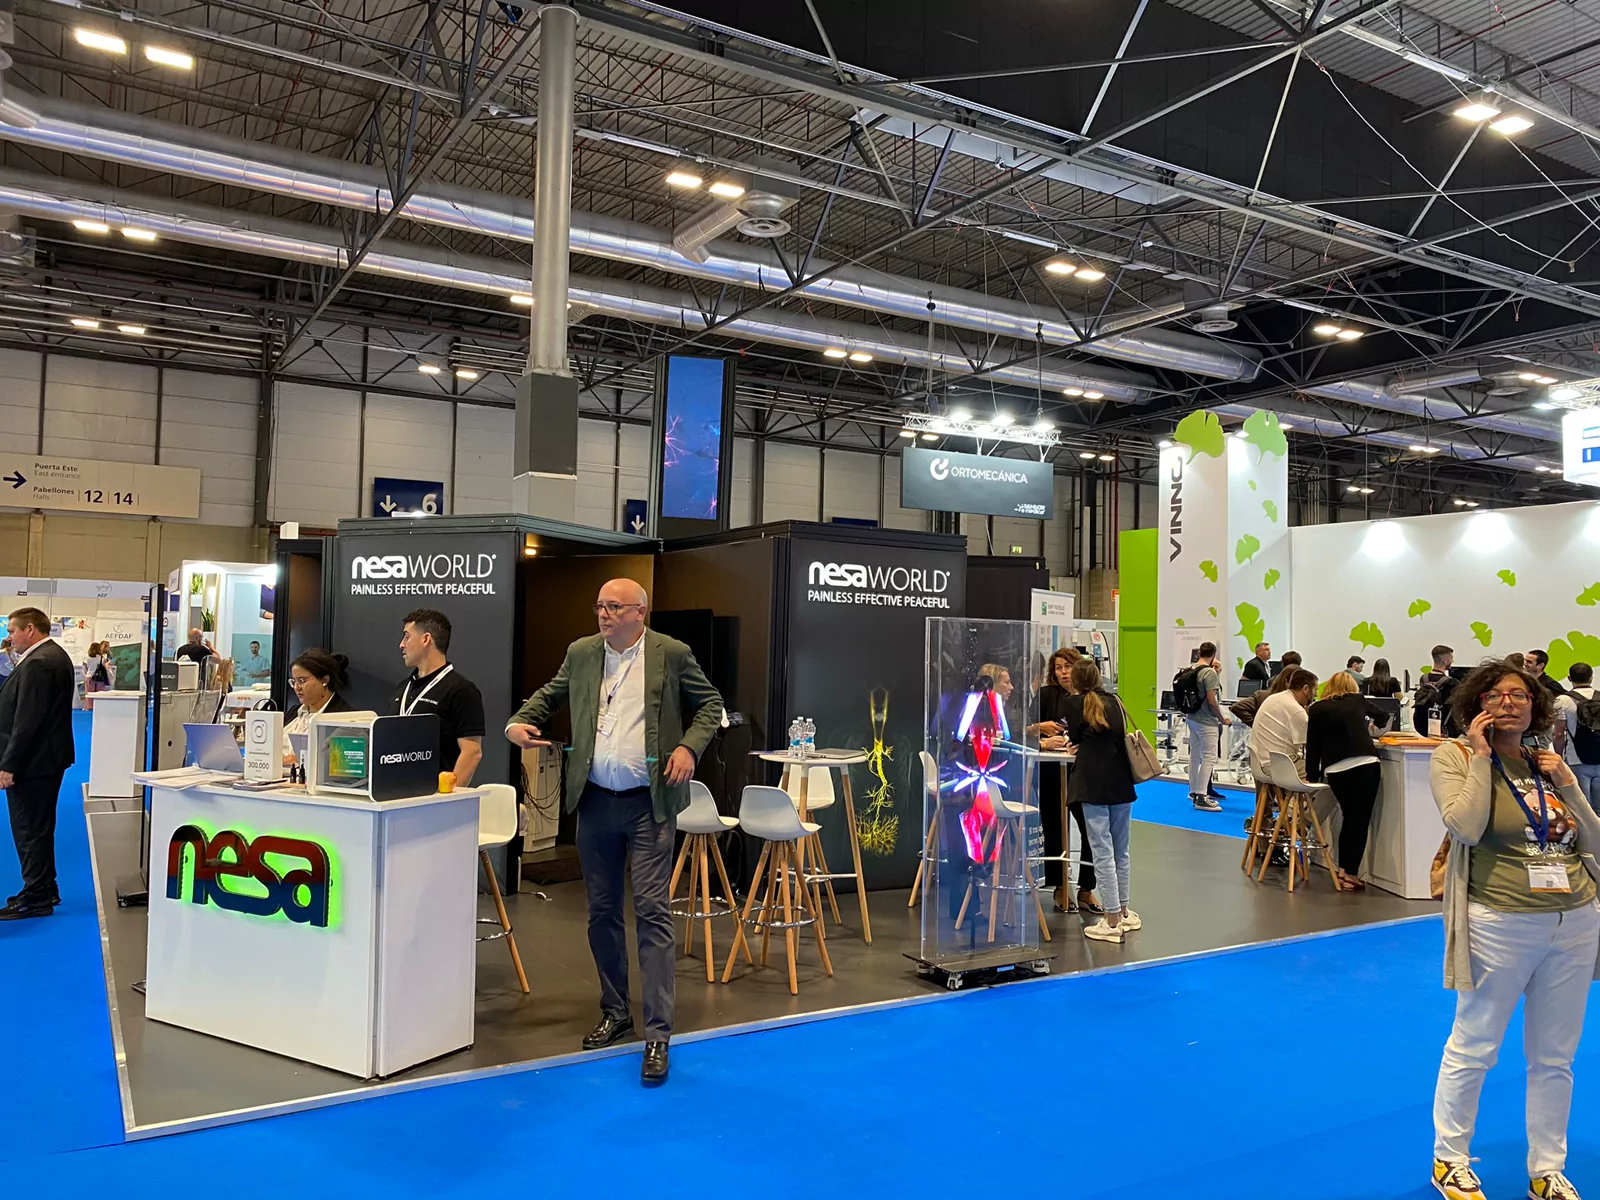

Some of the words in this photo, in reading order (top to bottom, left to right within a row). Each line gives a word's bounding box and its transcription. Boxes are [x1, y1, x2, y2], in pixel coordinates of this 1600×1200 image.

[34, 462, 61, 471] Puerta
[62, 464, 78, 472] Este
[50, 472, 81, 480] entrance
[951, 466, 1028, 484] ORTOMECÁNICA
[33, 485, 75, 495] Pabellones
[84, 490, 103, 504] 12
[113, 491, 134, 506] 14
[33, 493, 50, 501] Halls
[421, 493, 437, 515] 6
[352, 554, 496, 579] nesaWORLD
[808, 561, 950, 593] nesaWORLD
[351, 583, 393, 595] PAINLESS
[395, 583, 443, 595] EFFECTIVE
[445, 583, 496, 595] PEACEFUL
[808, 590, 853, 604] PAINLESS
[854, 593, 903, 607] EFFECTIVE
[904, 596, 951, 609] PEACEFUL
[248, 761, 269, 770] 300.000
[380, 750, 432, 765] nesaWORLD
[166, 825, 331, 927] nesa
